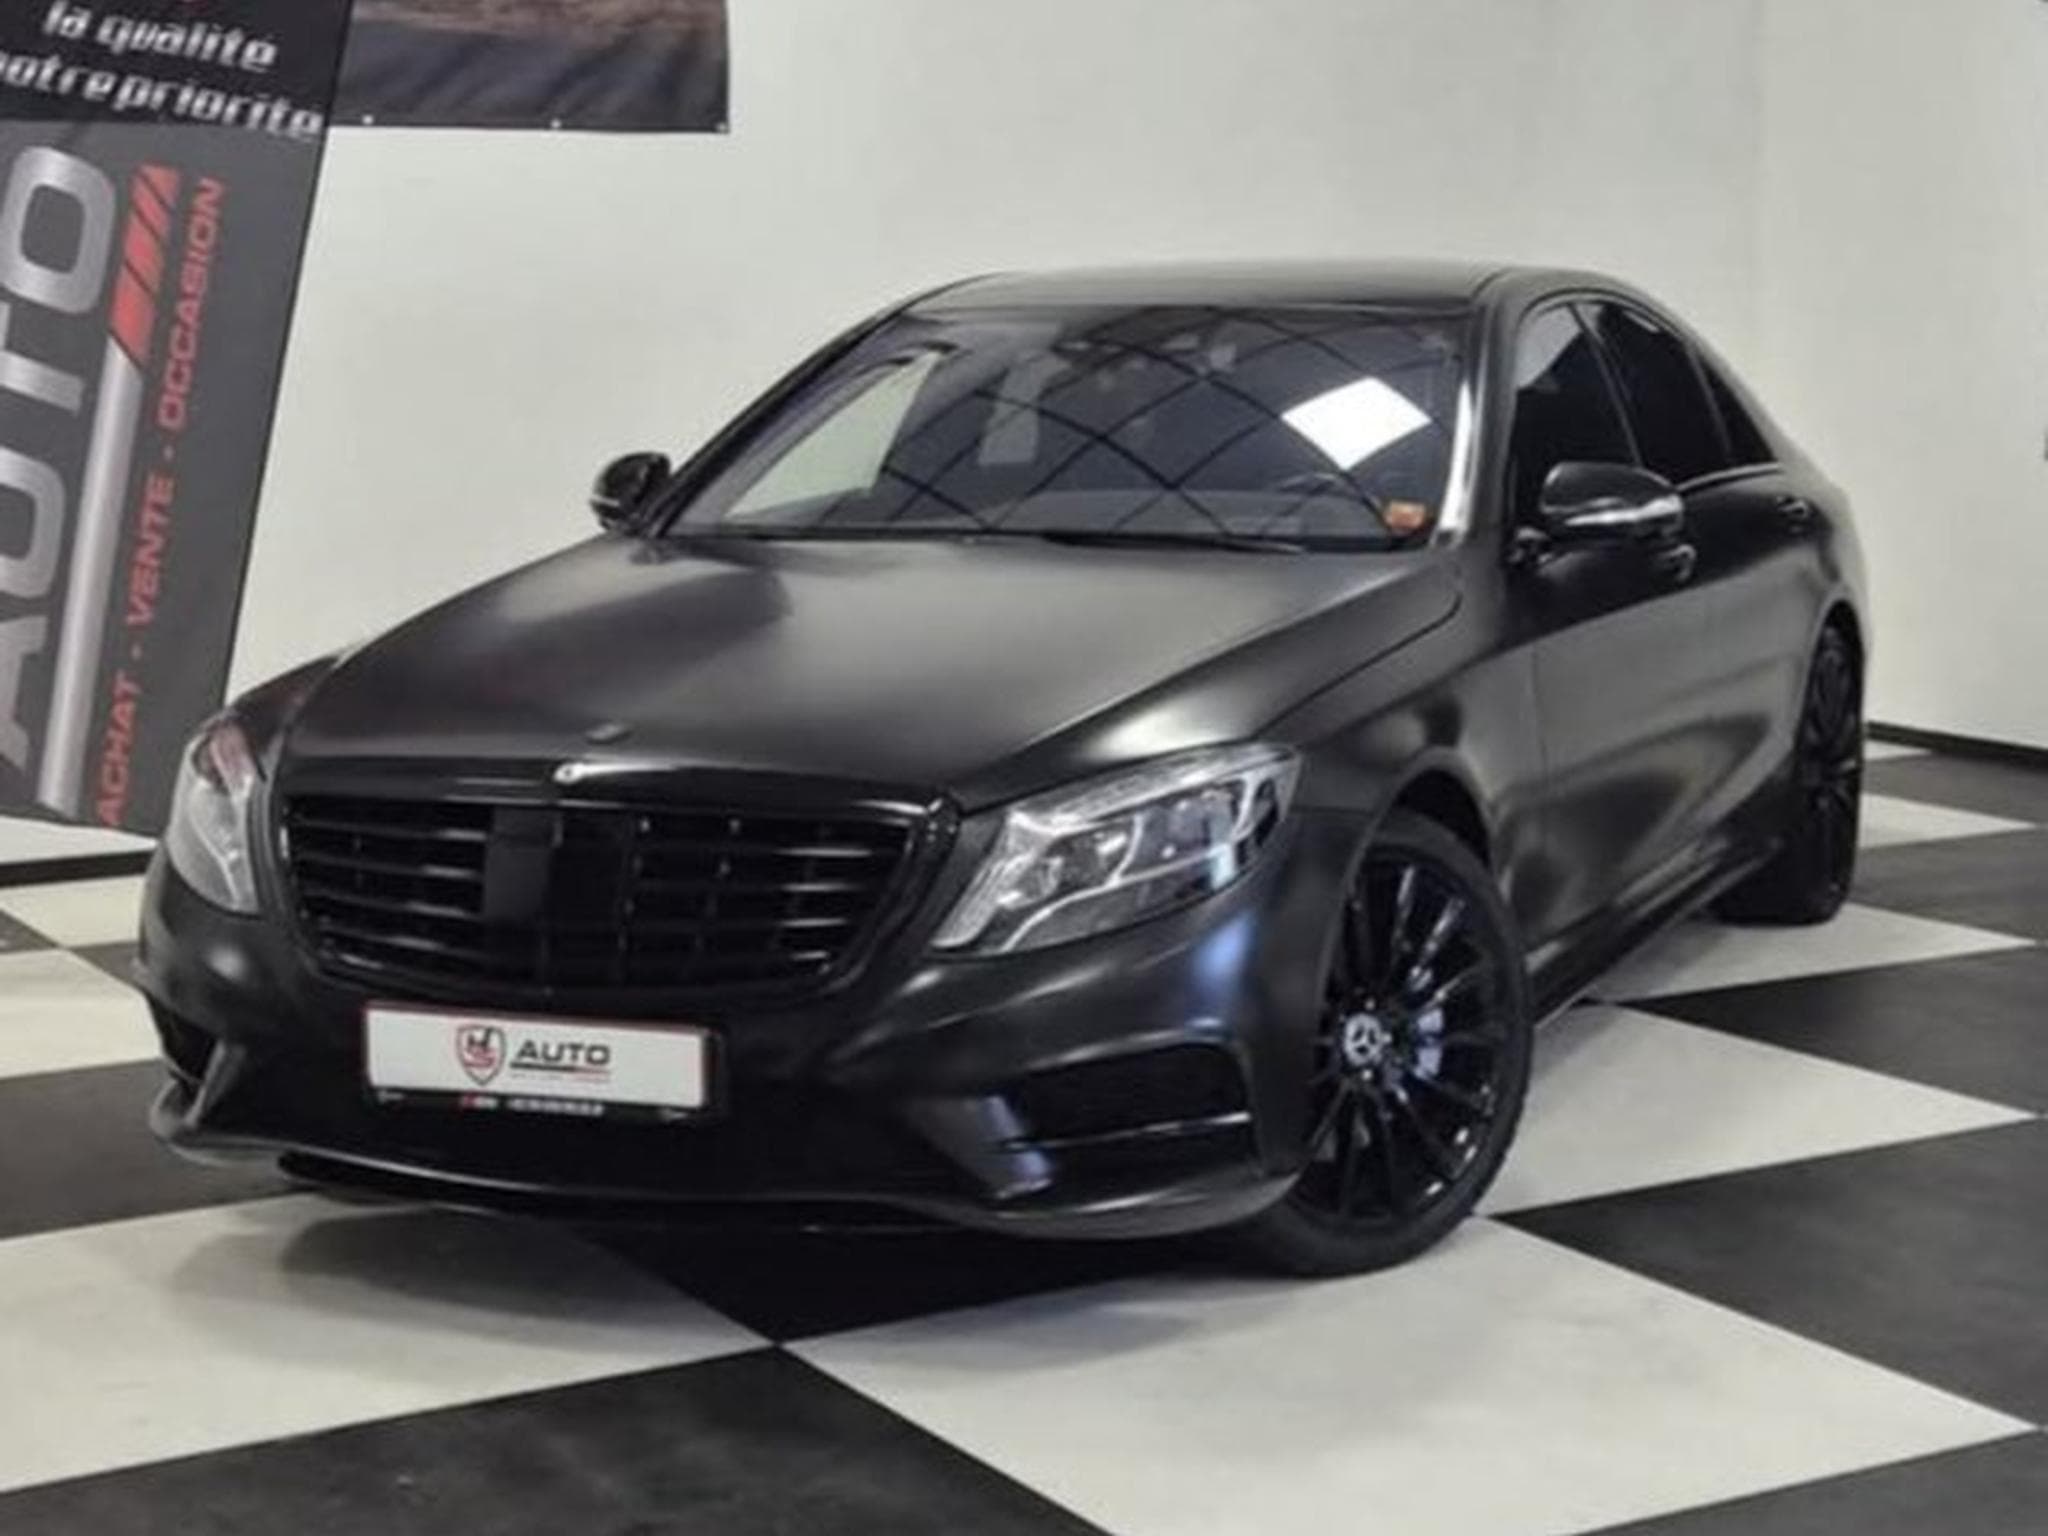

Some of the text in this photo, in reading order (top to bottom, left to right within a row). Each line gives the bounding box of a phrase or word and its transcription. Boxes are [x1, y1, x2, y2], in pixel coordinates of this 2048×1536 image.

[43, 0, 92, 39] la
[0, 51, 117, 101] otre
[96, 669, 141, 825] ACHAT
[126, 471, 176, 625] VENTE
[157, 177, 225, 431] OCCASION
[516, 1039, 610, 1066] AUTO
